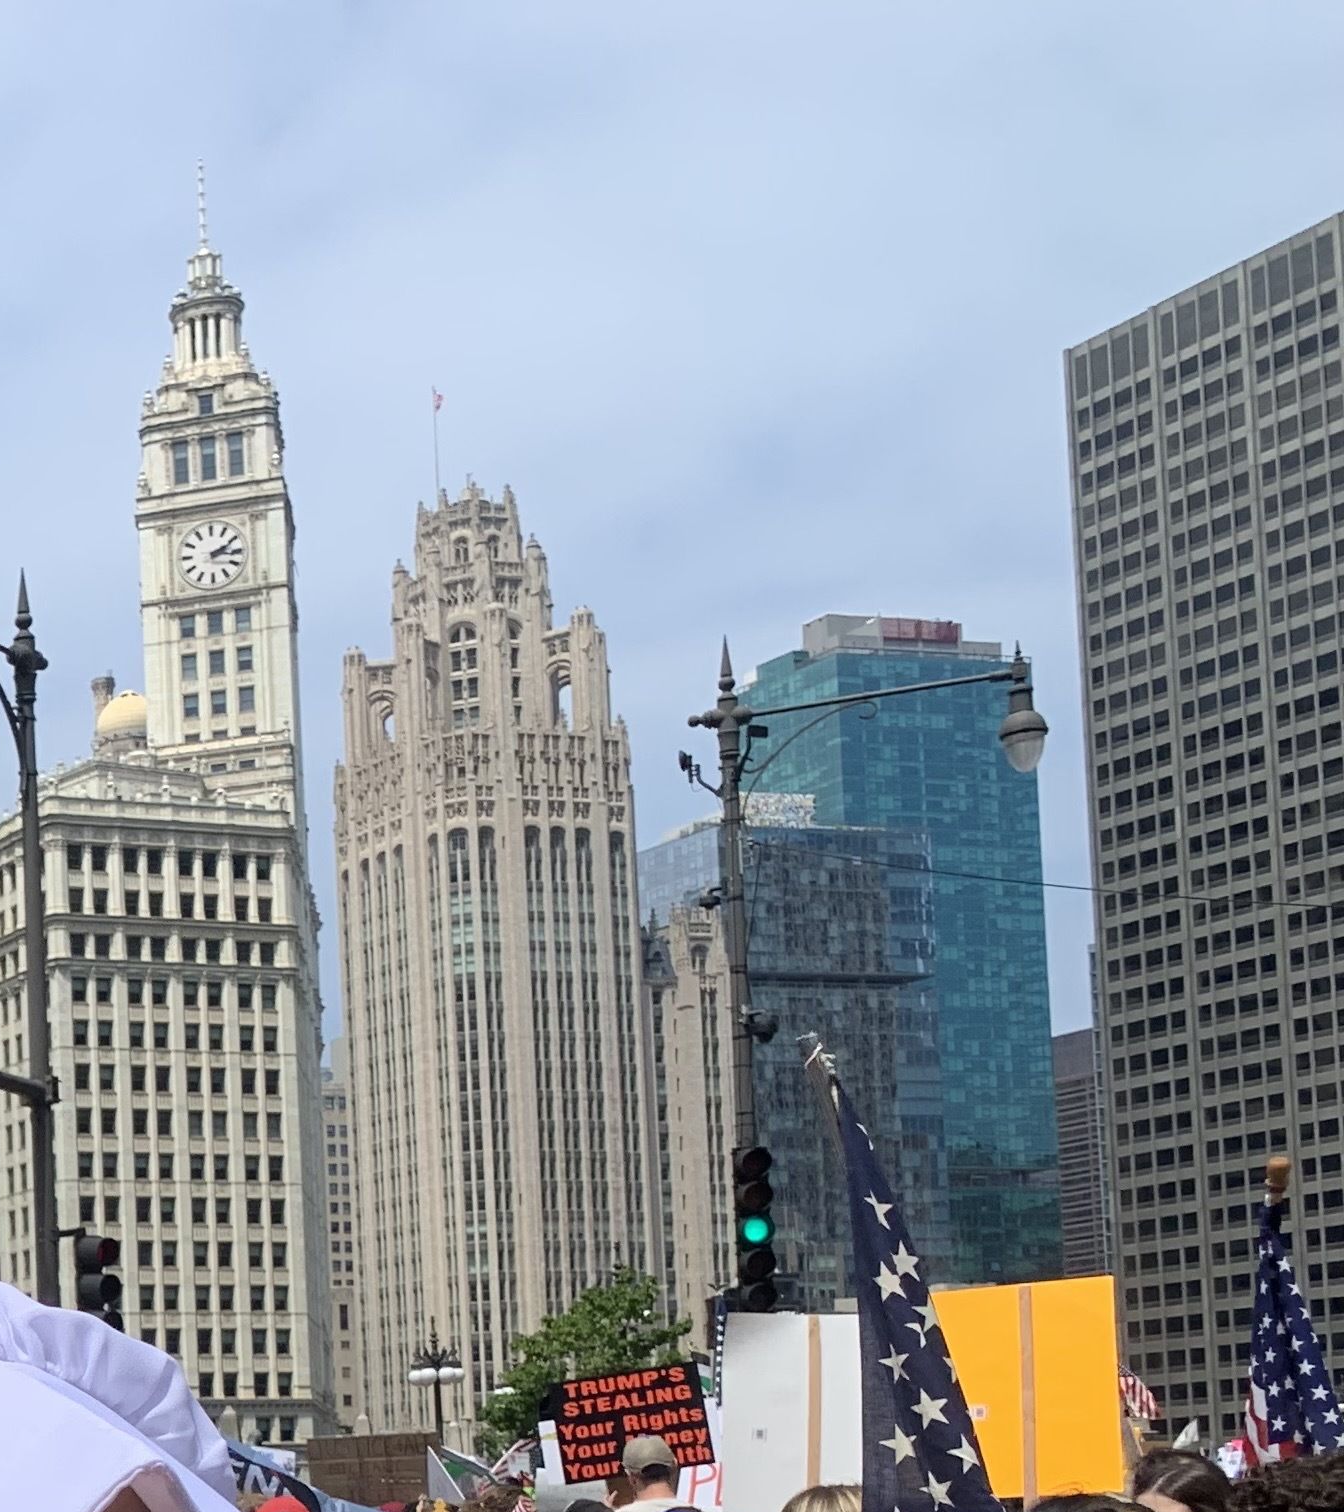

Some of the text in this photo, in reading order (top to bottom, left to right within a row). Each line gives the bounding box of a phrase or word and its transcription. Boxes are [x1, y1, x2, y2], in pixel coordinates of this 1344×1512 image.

[562, 1366, 686, 1398] TRUMP'S
[562, 1384, 693, 1418] STEALING
[559, 1406, 705, 1441] Your Rights
[562, 1440, 617, 1461] Your
[565, 1459, 621, 1481] Your
